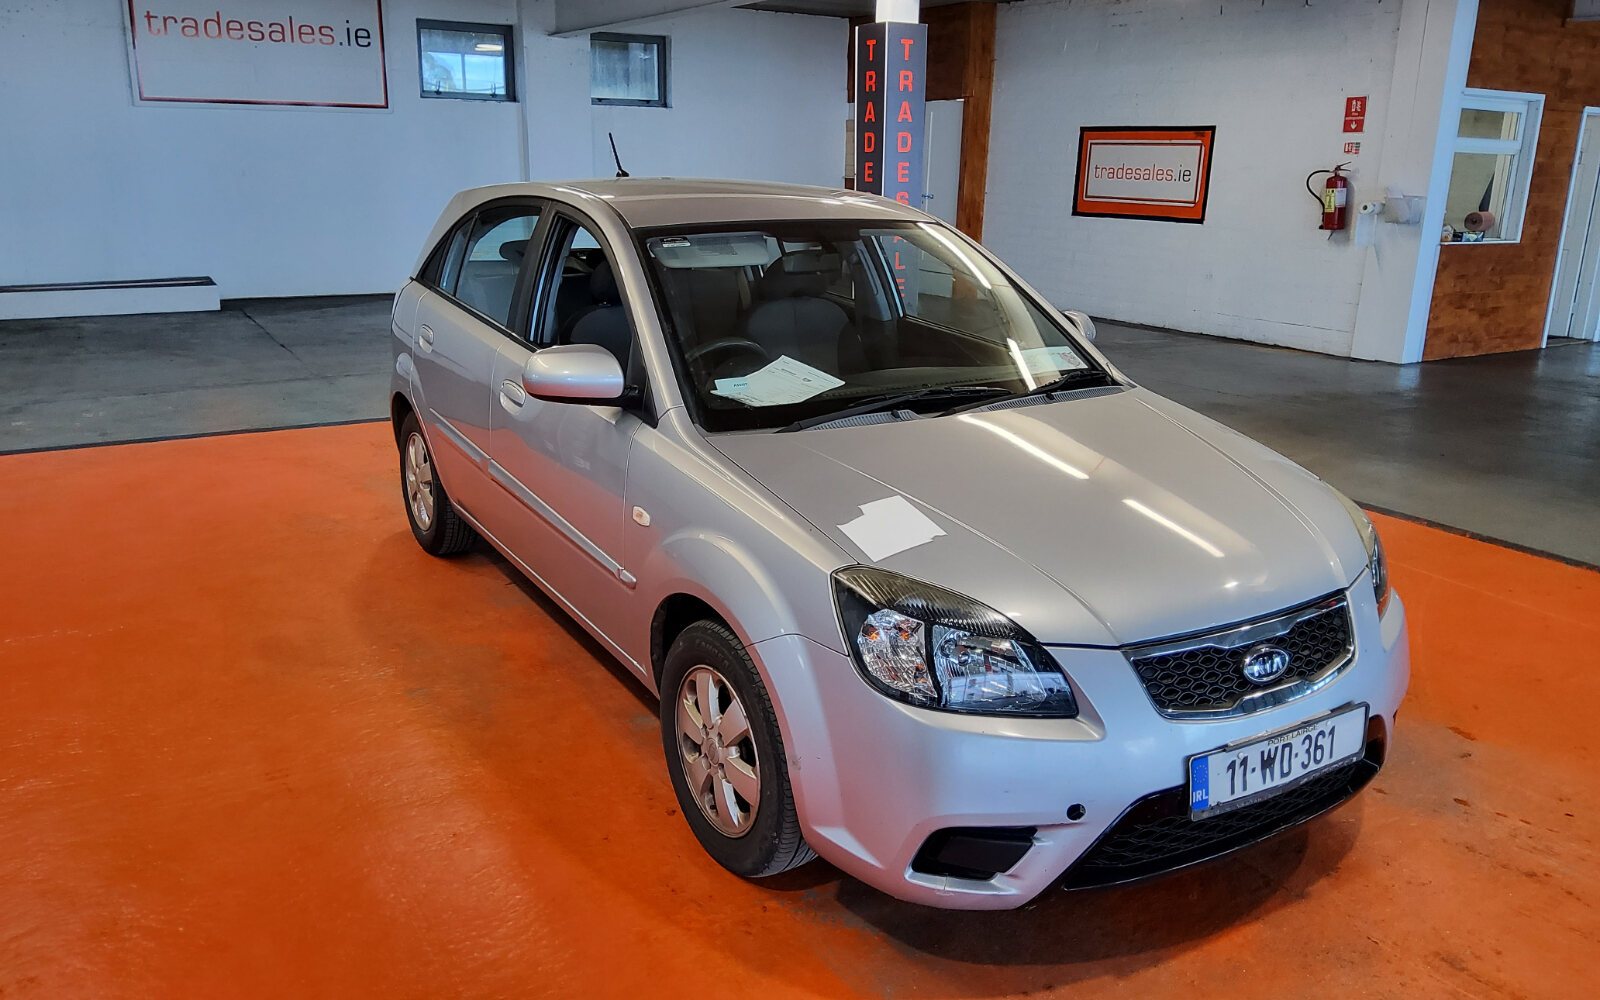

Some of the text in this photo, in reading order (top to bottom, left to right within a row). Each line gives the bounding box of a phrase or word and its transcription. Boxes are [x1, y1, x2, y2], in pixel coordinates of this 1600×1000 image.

[144, 11, 372, 48] tradesales.ie
[864, 39, 877, 194] TRADE
[1094, 163, 1192, 183] tradesales.ie
[1251, 653, 1283, 677] KIA
[1267, 734, 1291, 746] PORT
[1192, 788, 1209, 803] IRL
